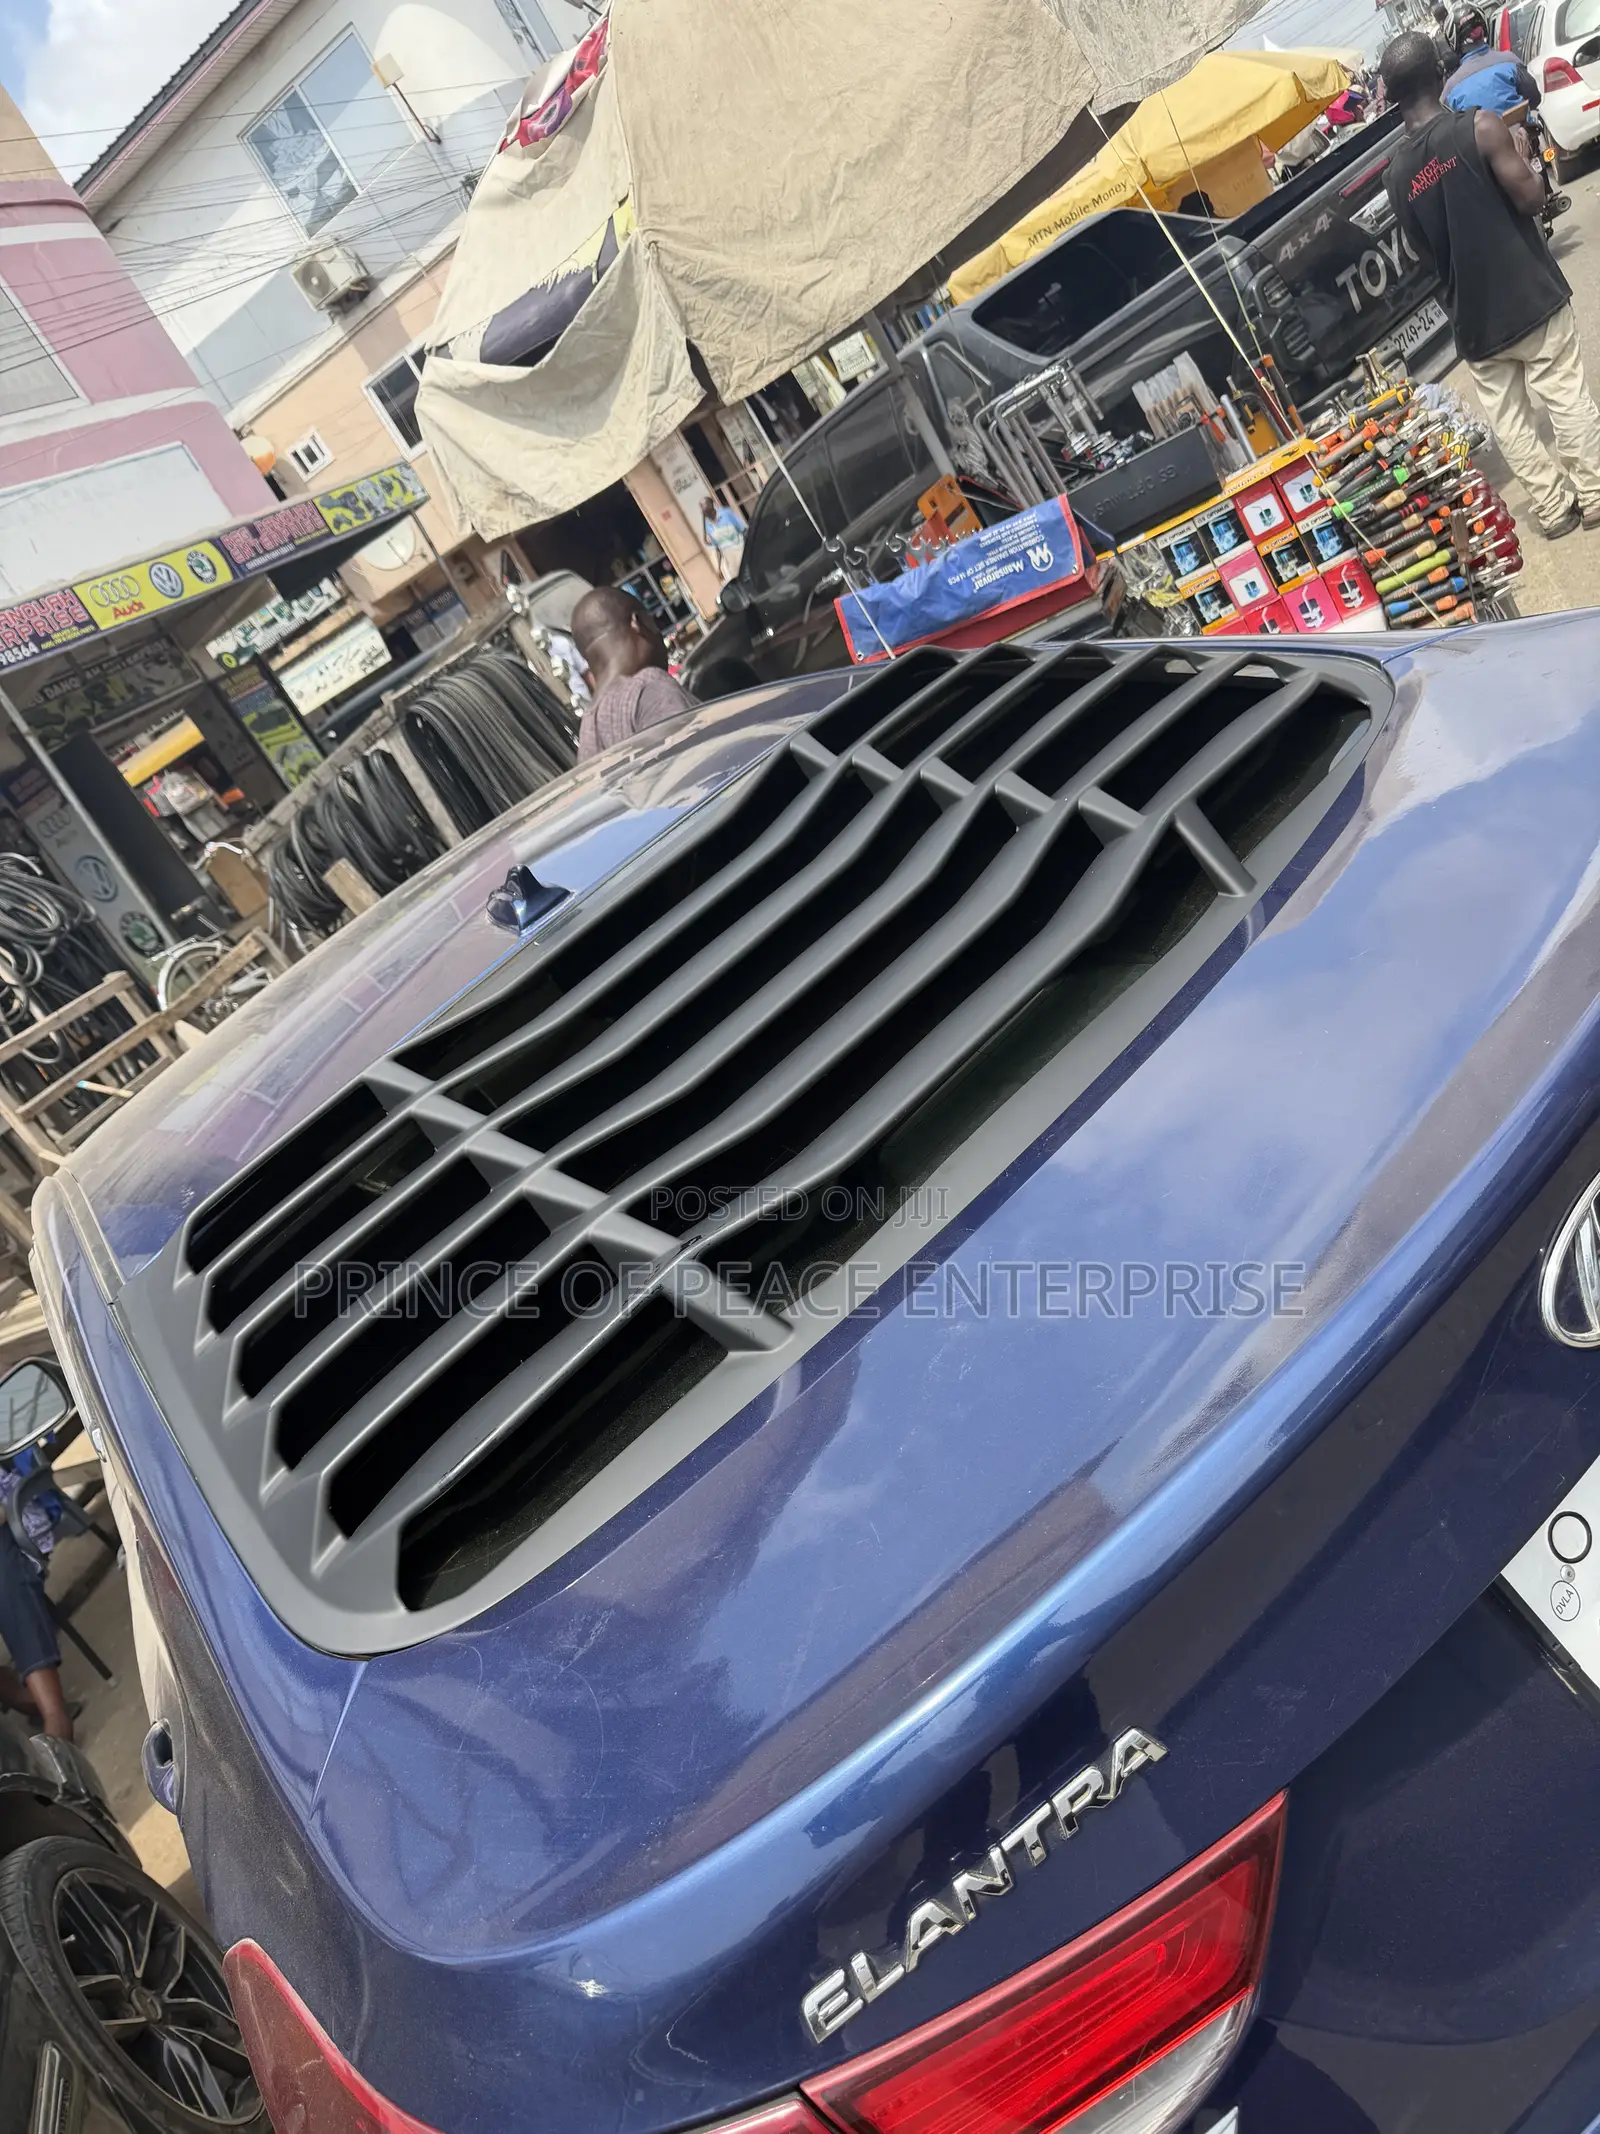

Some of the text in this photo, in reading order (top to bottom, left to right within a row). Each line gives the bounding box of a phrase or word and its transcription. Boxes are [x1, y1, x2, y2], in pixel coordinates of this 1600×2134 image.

[1027, 225, 1053, 248] MTN
[1053, 204, 1090, 233] Mobile
[1091, 179, 1128, 209] Money
[974, 560, 1024, 590] Mansarovar
[112, 599, 146, 620] Audi
[1555, 1589, 1574, 1615] DVLA
[801, 1725, 1170, 2045] ELANTRA
